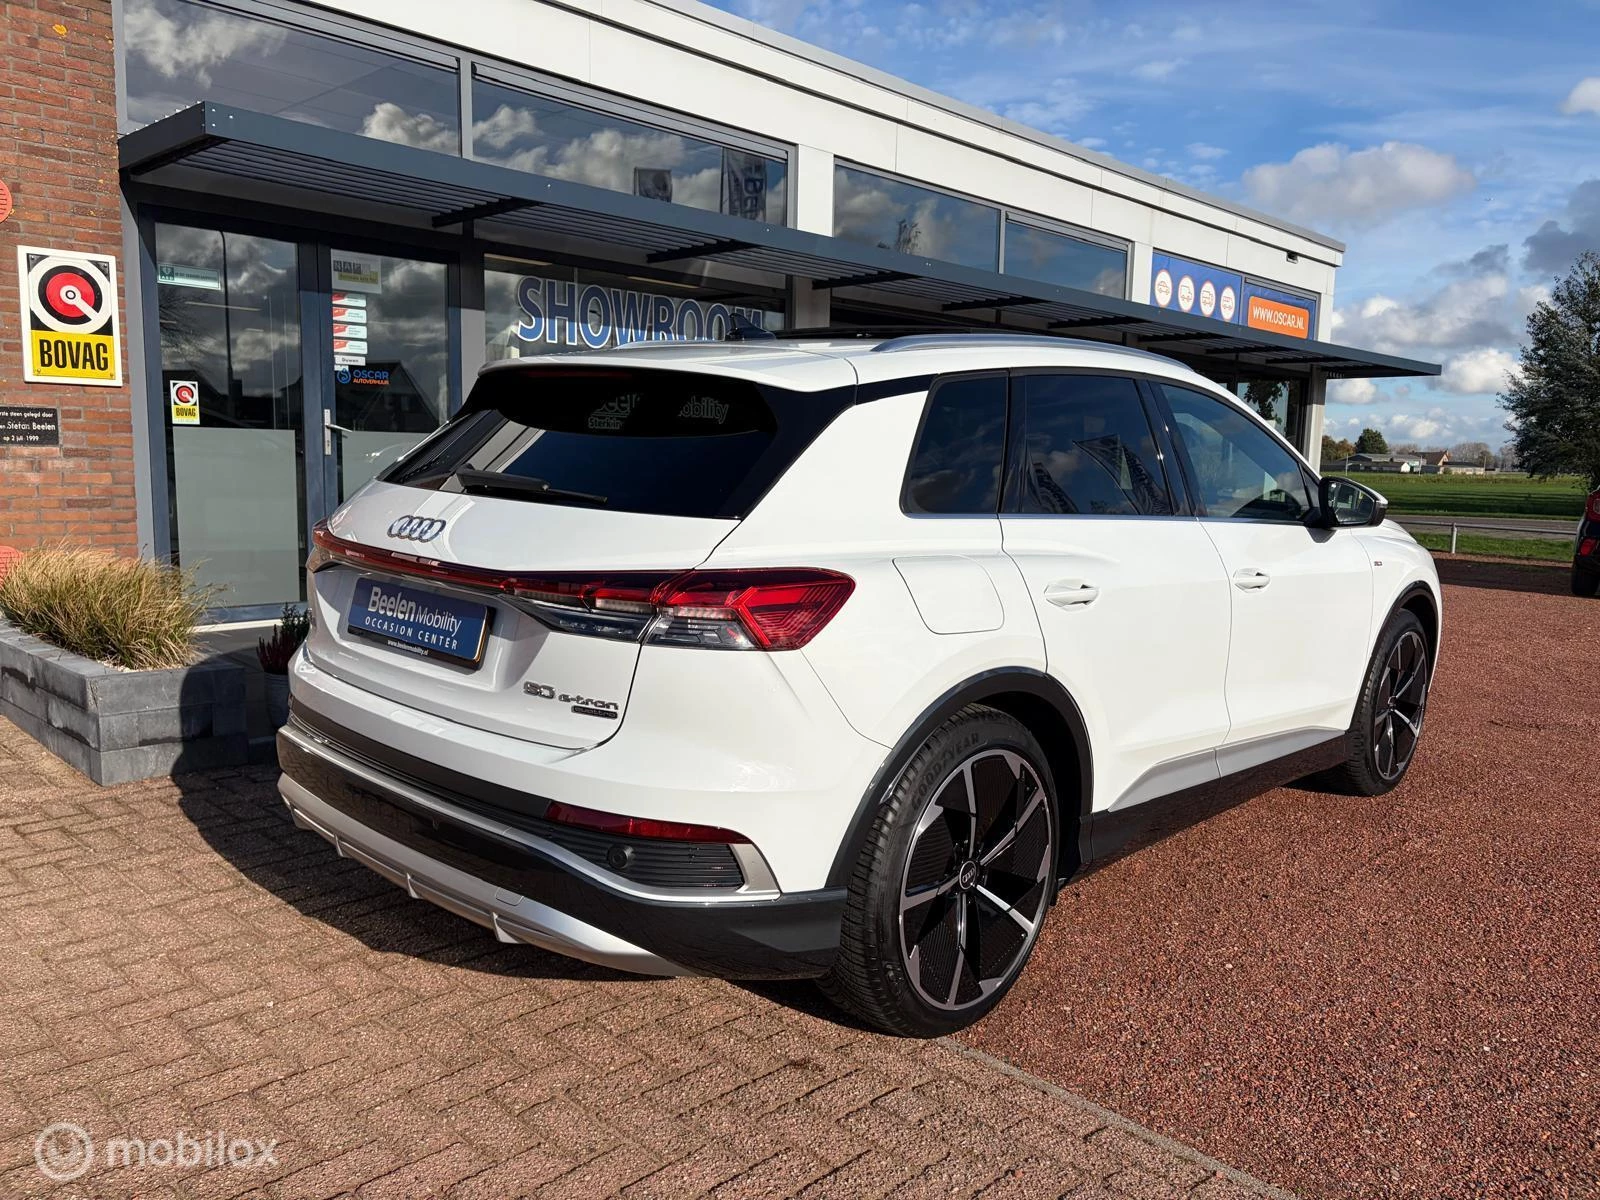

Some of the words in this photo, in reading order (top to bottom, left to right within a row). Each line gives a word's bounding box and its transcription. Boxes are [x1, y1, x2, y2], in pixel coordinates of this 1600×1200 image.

[1252, 306, 1305, 330] WWW.OSCAR.NL
[39, 338, 109, 371] BOVAG
[353, 369, 390, 380] OSCAR
[176, 407, 196, 417] BOVAG
[677, 395, 729, 424] obility
[7, 421, 30, 430] Stefan
[32, 422, 56, 430] Beelen
[367, 586, 416, 622] Beelen
[416, 606, 461, 637] Mobility
[365, 616, 413, 637] OCCASION
[418, 630, 458, 650] CENTER
[558, 694, 619, 710] e-tron
[573, 706, 617, 719] quattro
